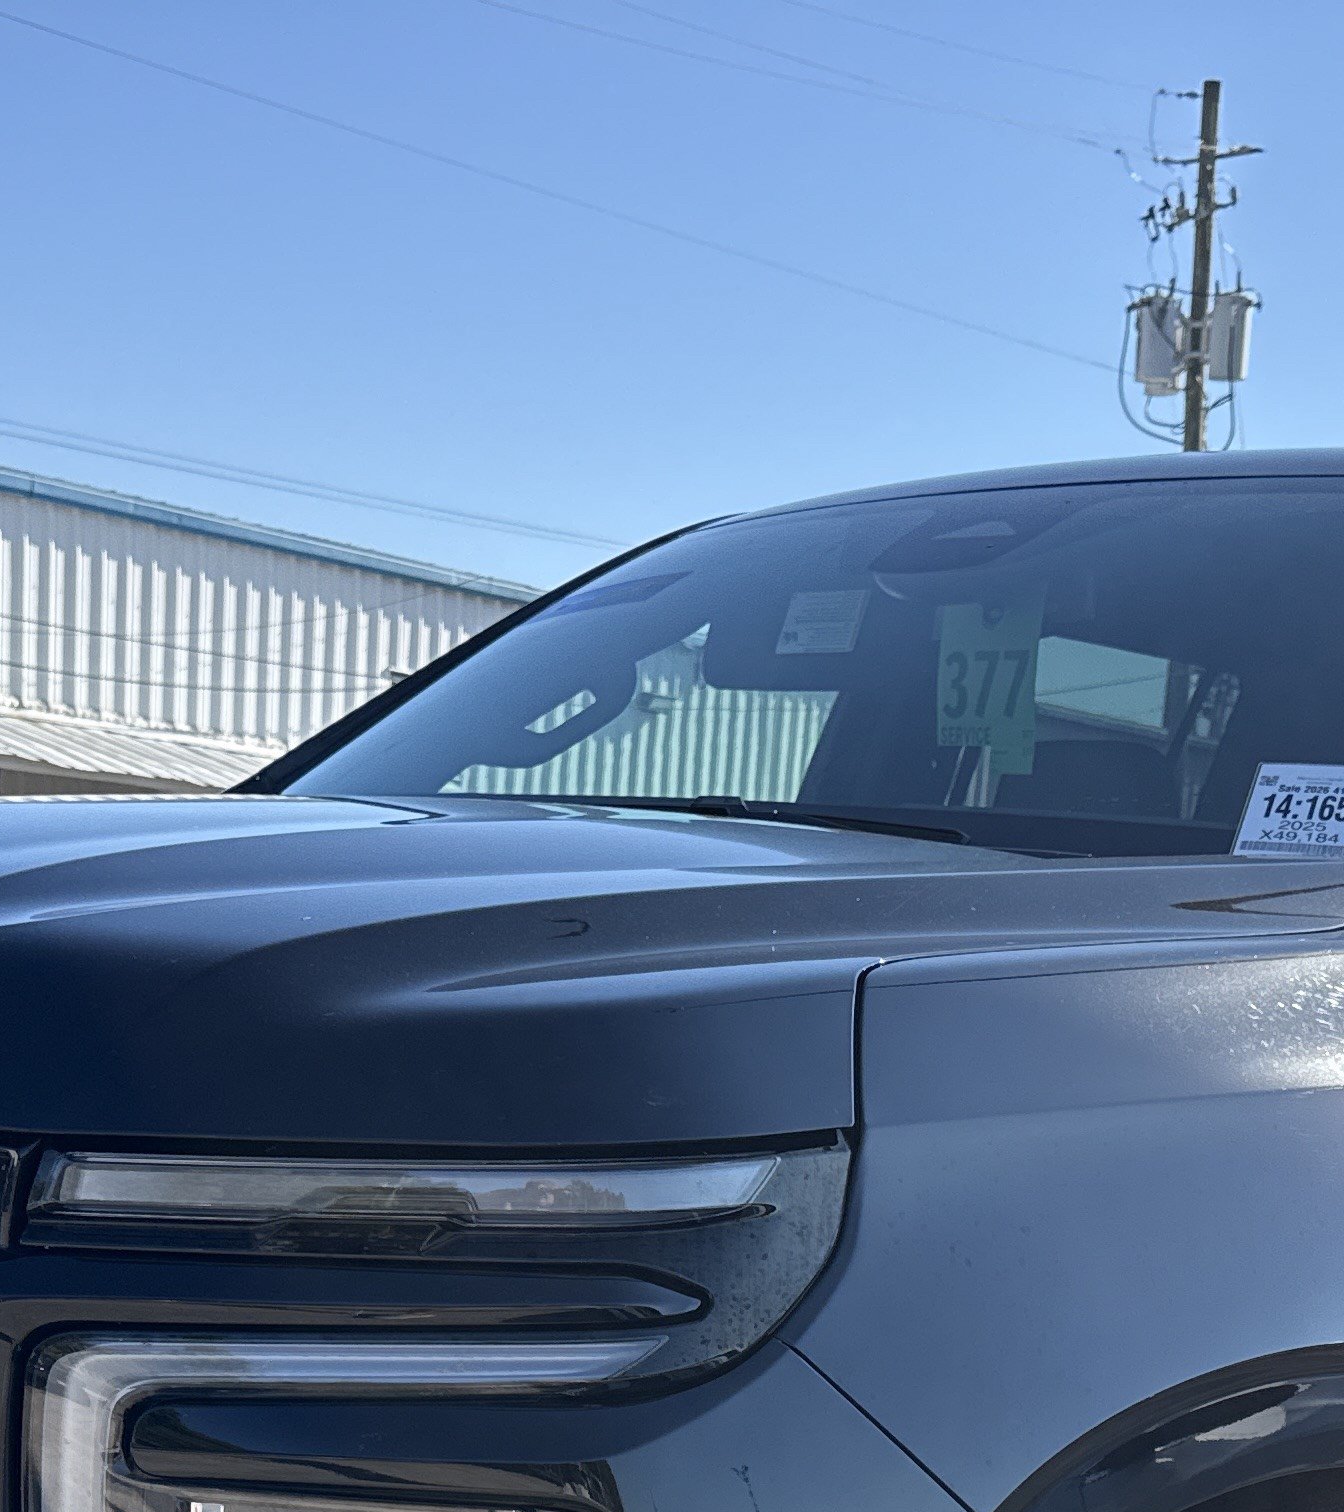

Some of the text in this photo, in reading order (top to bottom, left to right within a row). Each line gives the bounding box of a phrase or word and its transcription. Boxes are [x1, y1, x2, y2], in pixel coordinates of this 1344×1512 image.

[942, 650, 1030, 720] 377
[940, 725, 991, 745] SERVICE
[1278, 820, 1327, 832] 2025
[1258, 829, 1339, 844] X49,184
